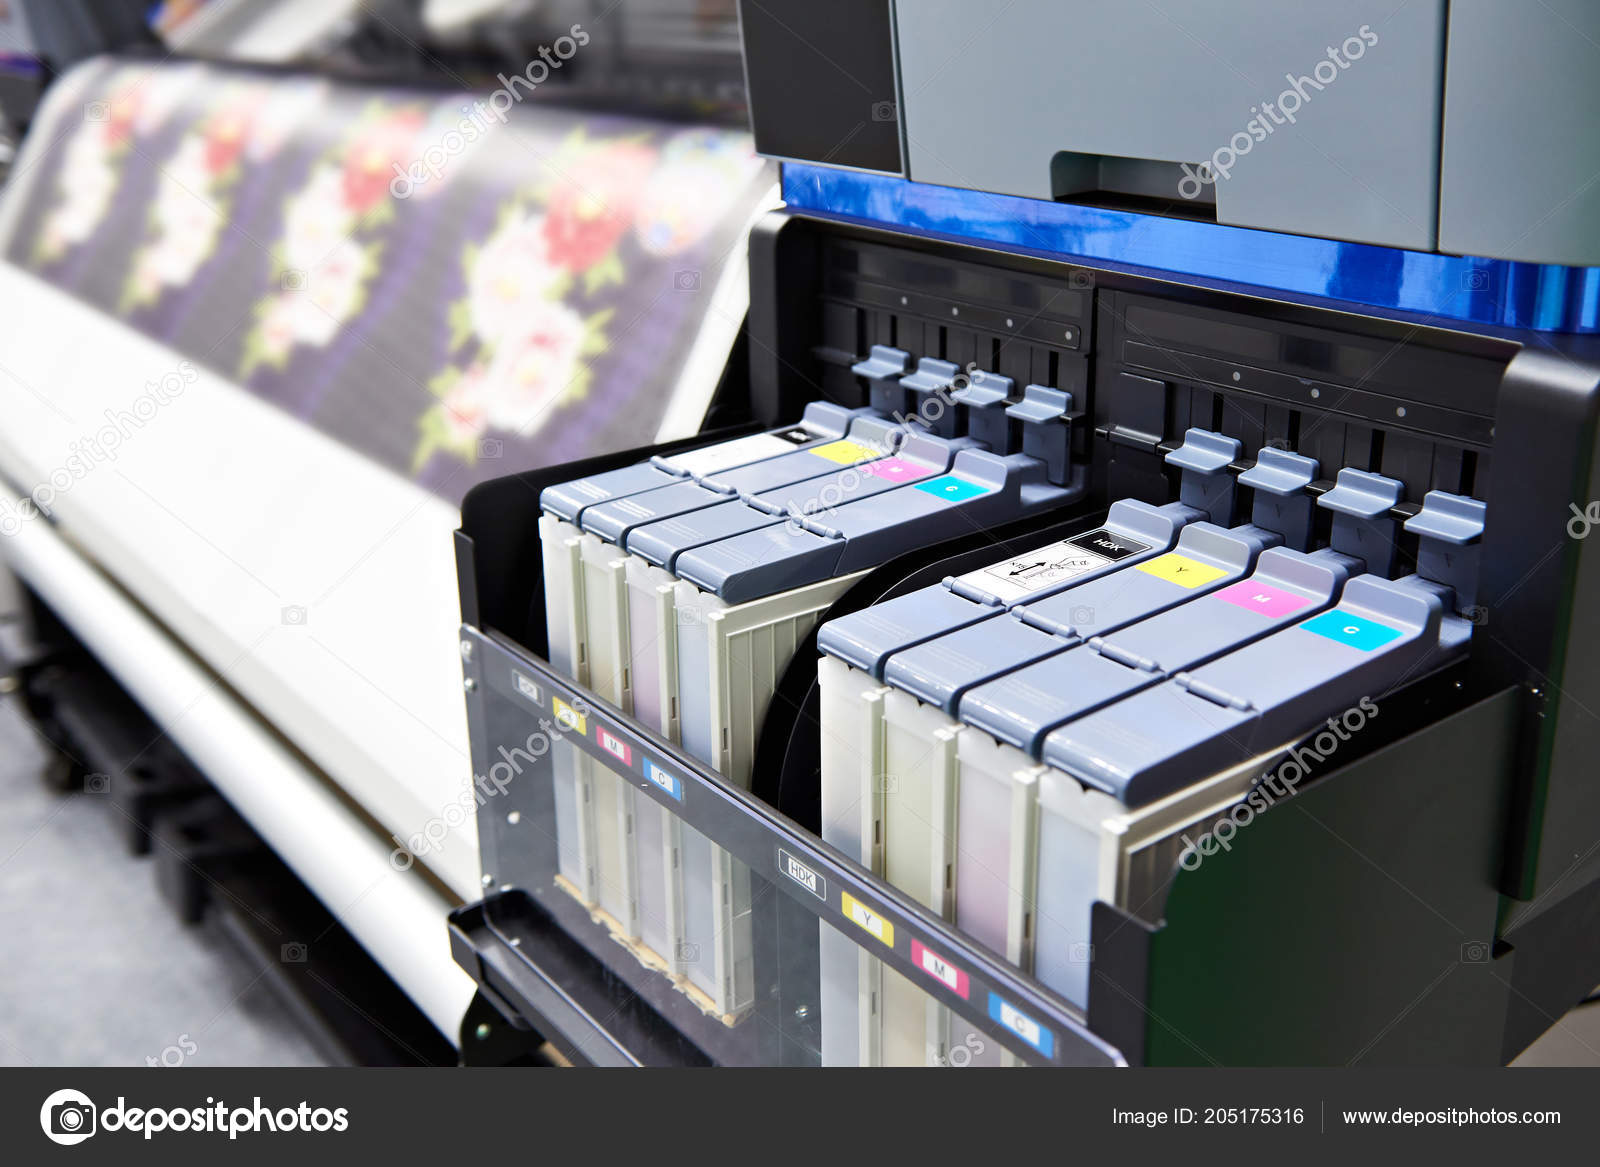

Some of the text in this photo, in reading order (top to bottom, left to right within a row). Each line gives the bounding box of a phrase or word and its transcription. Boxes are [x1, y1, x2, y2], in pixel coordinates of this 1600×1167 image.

[1093, 539, 1125, 552] HDK
[1252, 595, 1271, 603] M
[1343, 626, 1360, 634] C
[791, 863, 813, 887] HDK
[863, 911, 871, 925] Y
[934, 960, 945, 977] M
